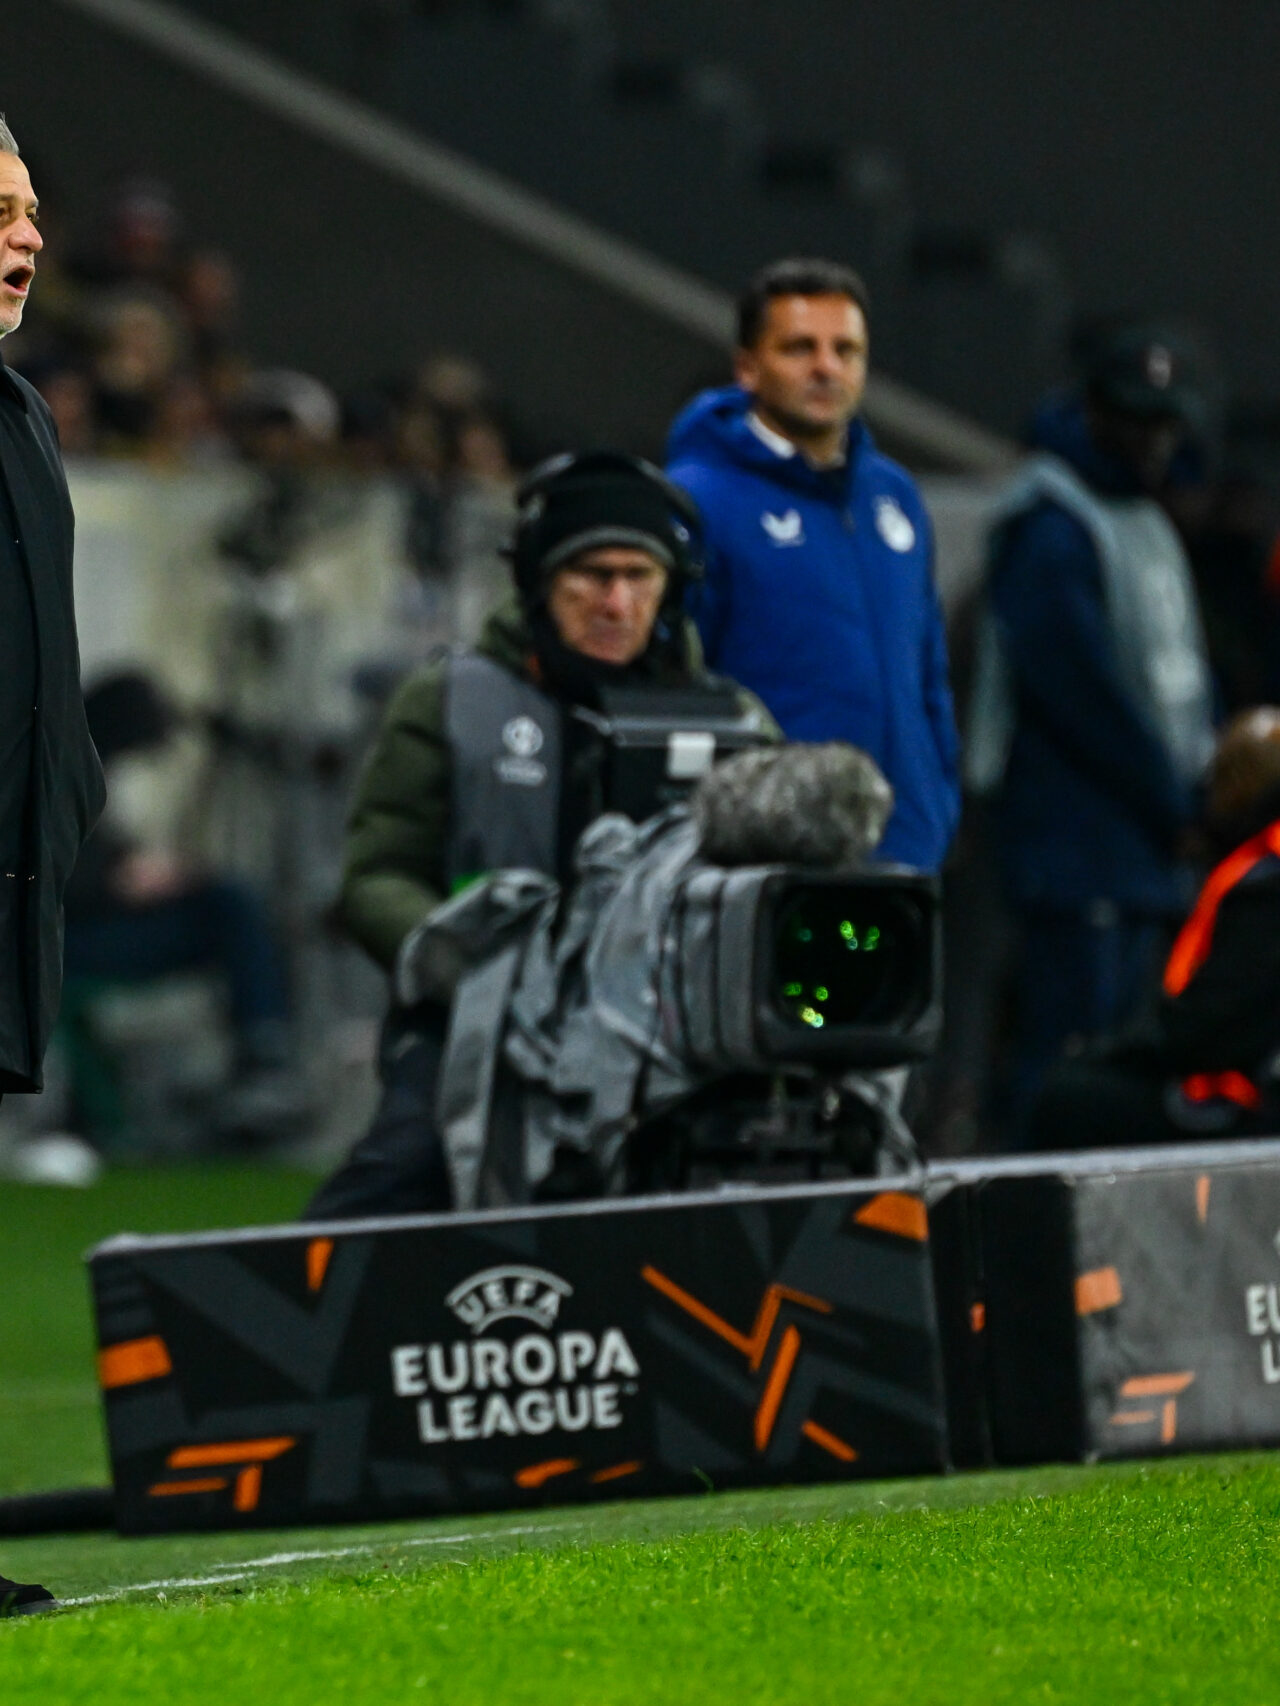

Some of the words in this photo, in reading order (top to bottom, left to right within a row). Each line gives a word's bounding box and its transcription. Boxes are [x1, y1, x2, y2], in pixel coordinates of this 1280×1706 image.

[451, 1278, 562, 1325] UEFA
[391, 1327, 640, 1396] EUROPA
[417, 1383, 622, 1443] LEAGUE
